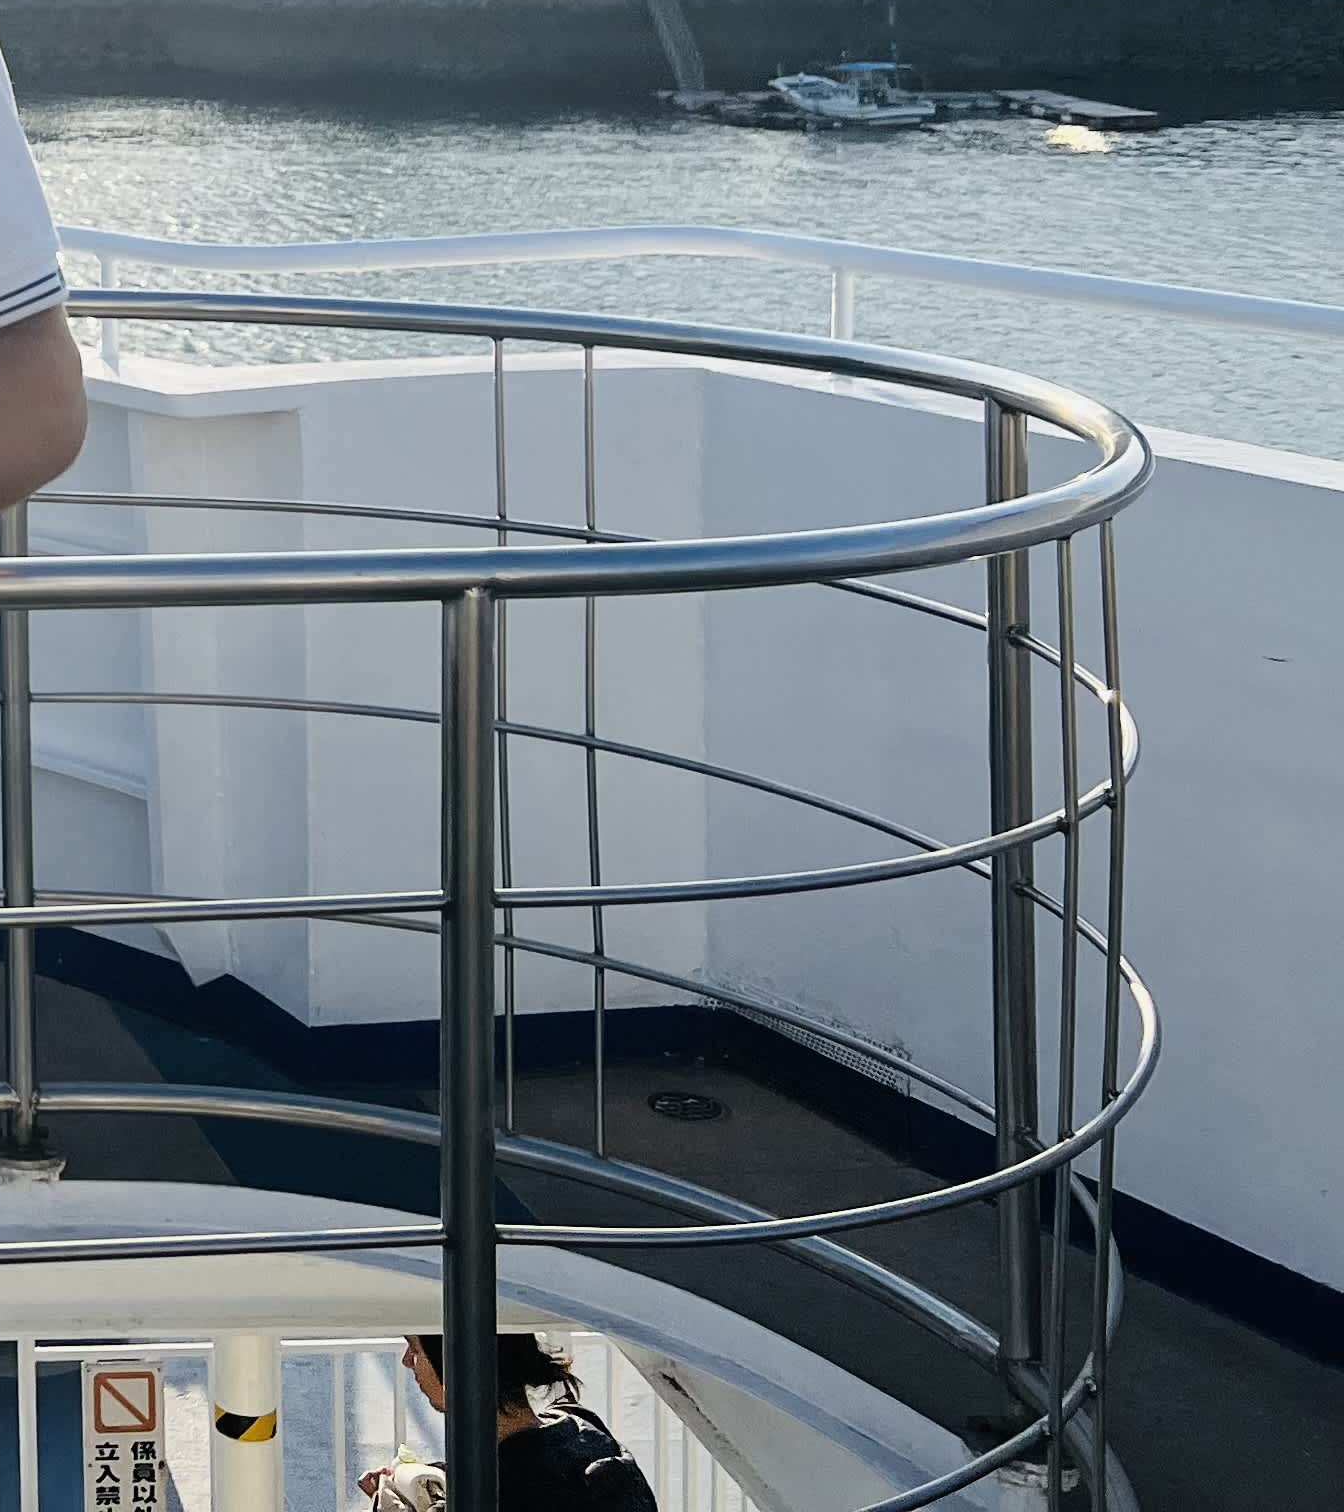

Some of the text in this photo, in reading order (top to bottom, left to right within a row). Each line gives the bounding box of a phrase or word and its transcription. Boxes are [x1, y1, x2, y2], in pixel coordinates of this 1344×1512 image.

[95, 1442, 120, 1512] 立入禁
[131, 1441, 157, 1512] 係員以
